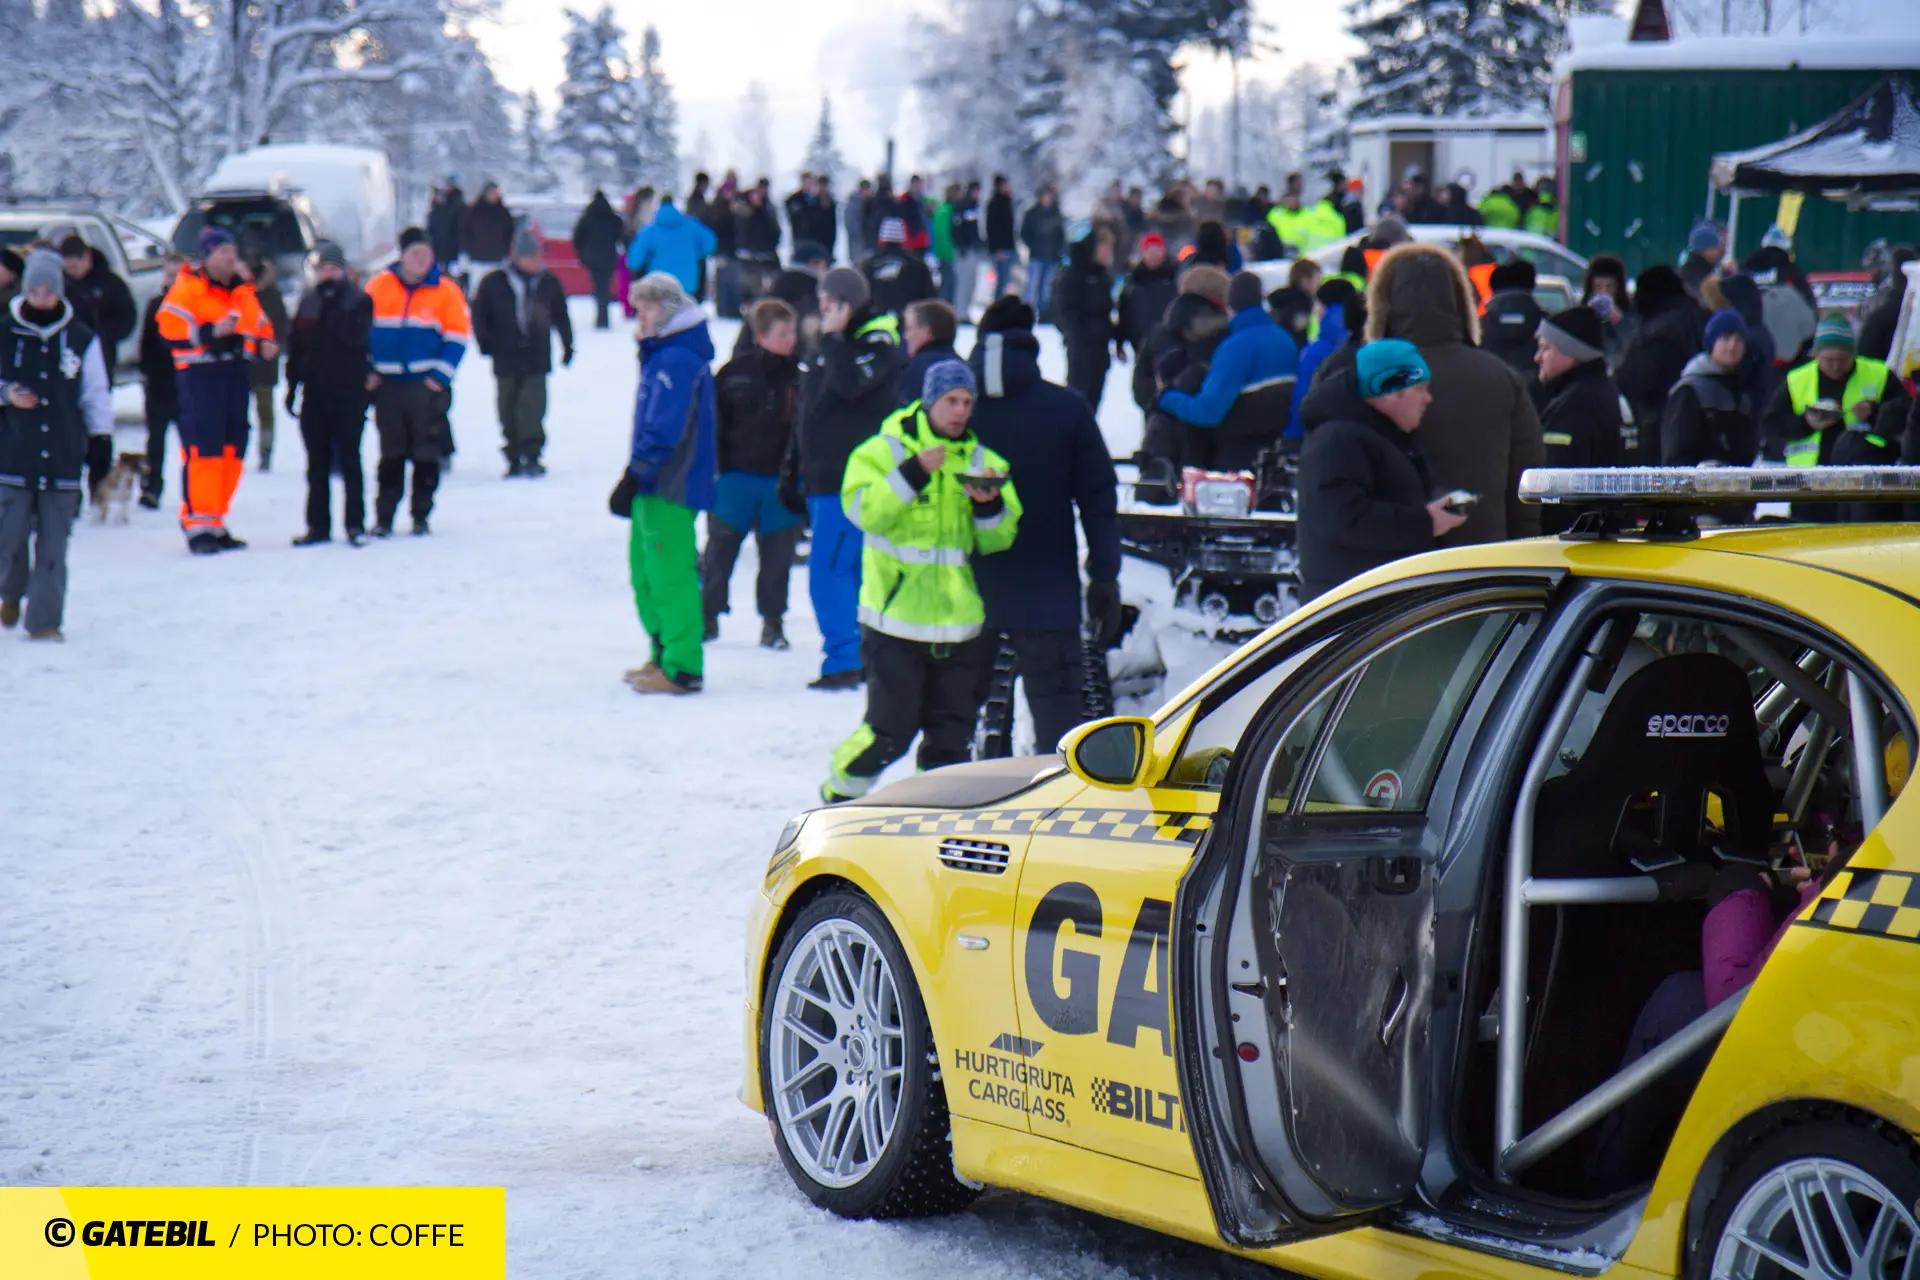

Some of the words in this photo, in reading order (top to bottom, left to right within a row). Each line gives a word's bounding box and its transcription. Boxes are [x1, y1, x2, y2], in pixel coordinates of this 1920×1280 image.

[1647, 714, 1730, 739] sparco
[954, 1048, 1076, 1099] HURTIGRUTA
[968, 1079, 1066, 1124] CARGLASS
